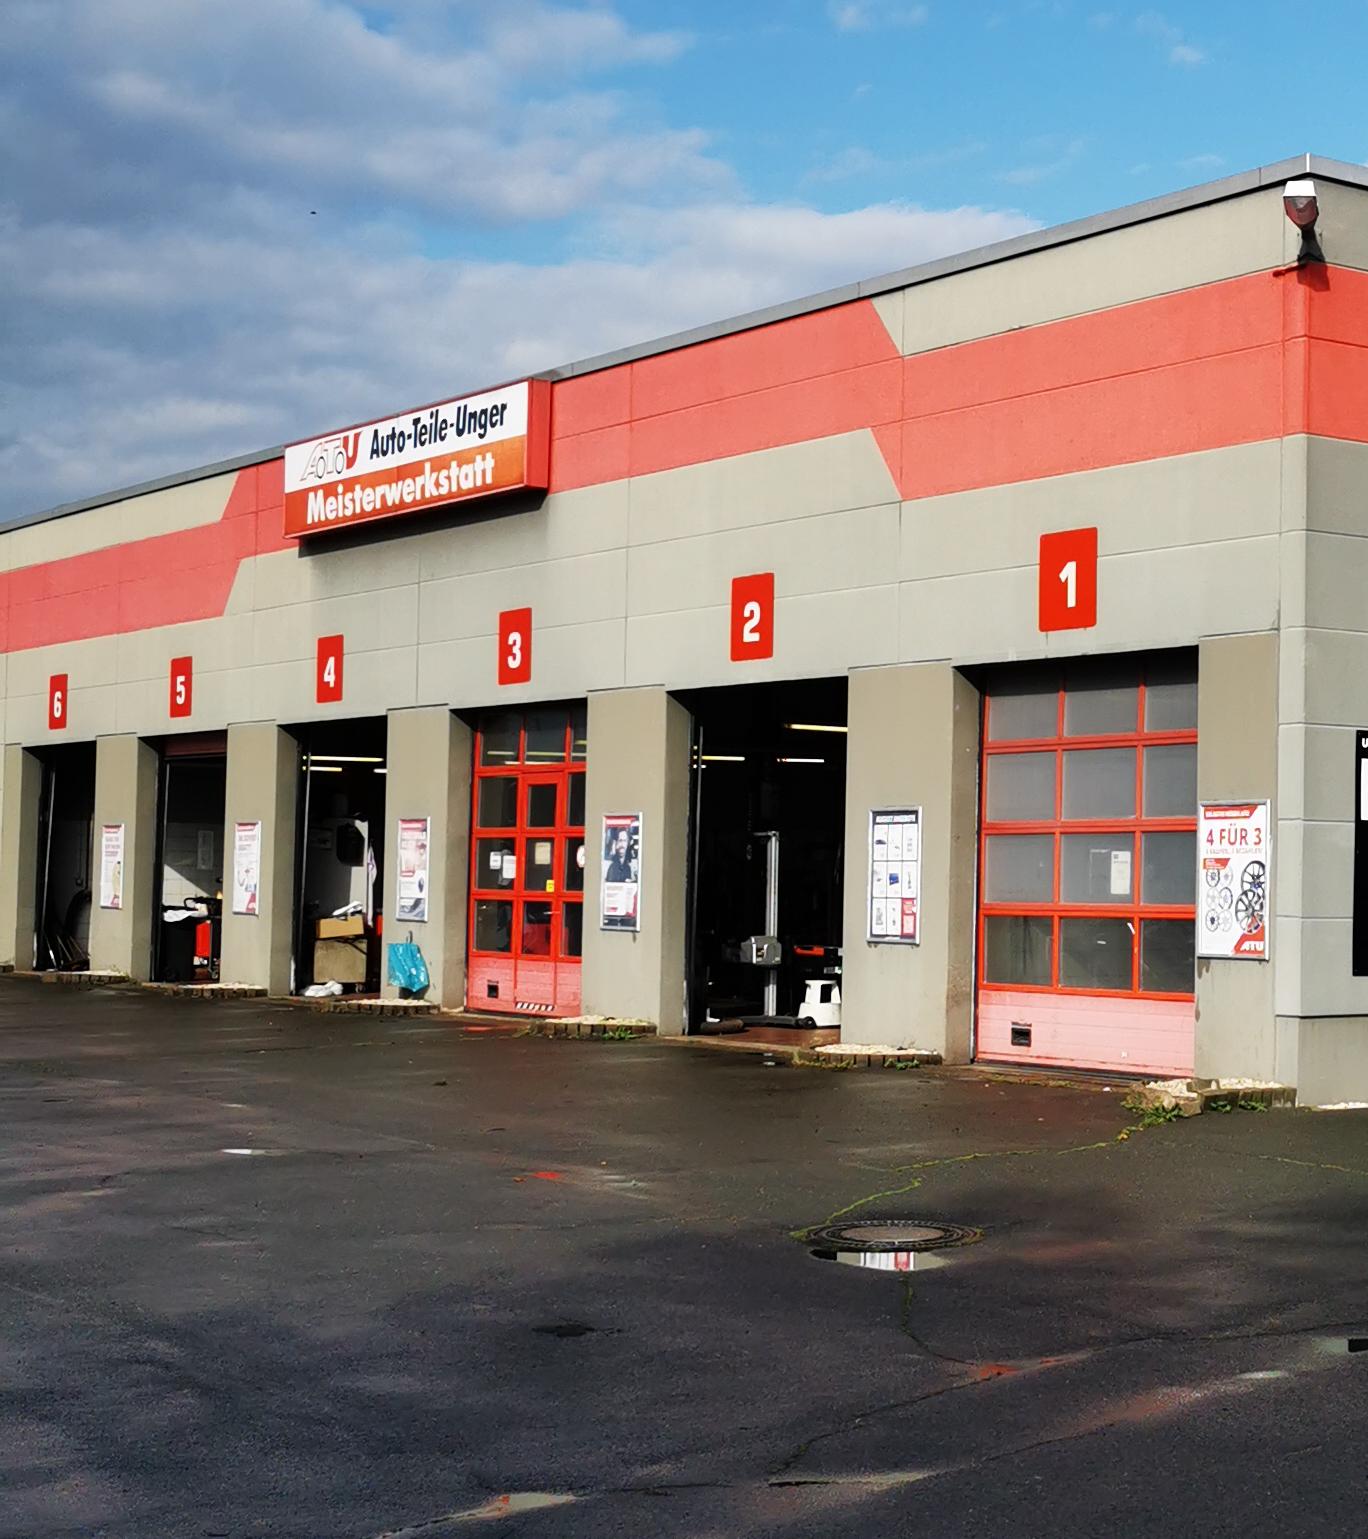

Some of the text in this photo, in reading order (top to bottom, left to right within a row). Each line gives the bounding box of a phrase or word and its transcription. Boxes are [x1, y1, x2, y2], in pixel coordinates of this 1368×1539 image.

[370, 403, 507, 459] Auto-Teile-Unger
[307, 452, 494, 524] Meisterwerkstatt
[1059, 560, 1076, 608] 1
[743, 601, 760, 642] 2
[507, 632, 521, 668] 3
[176, 675, 185, 704] 5
[323, 656, 335, 688] 4
[53, 691, 62, 718] 6
[1206, 823, 1262, 846] 4 FÜR 3
